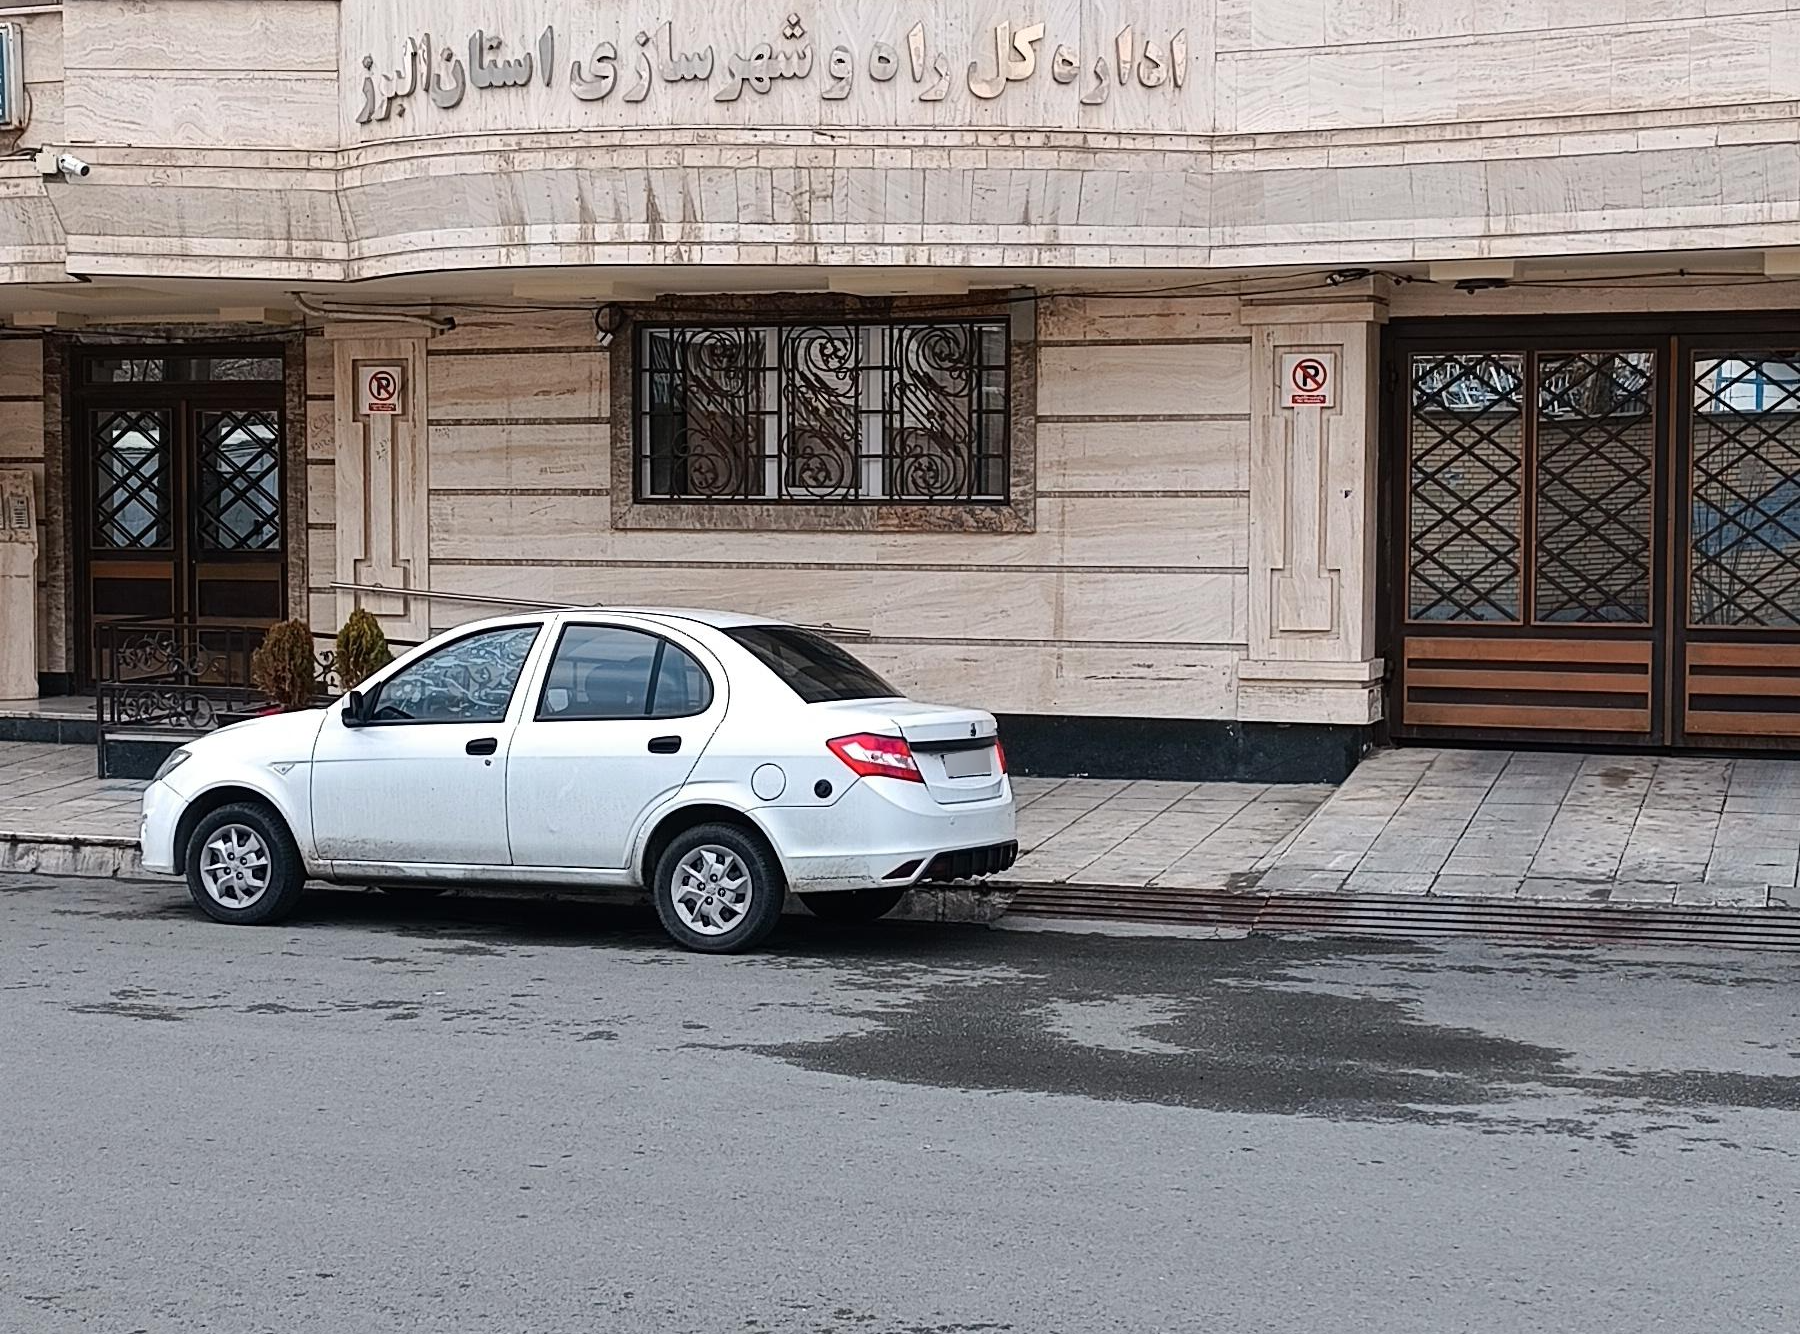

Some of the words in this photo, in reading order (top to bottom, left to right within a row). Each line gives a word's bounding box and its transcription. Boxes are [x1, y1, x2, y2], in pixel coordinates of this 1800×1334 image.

[355, 32, 432, 124] البرز
[430, 24, 555, 110] استان
[821, 44, 854, 100] و
[868, 19, 951, 102] راه
[966, 19, 1046, 99] کل
[1052, 24, 1189, 106] اداره
